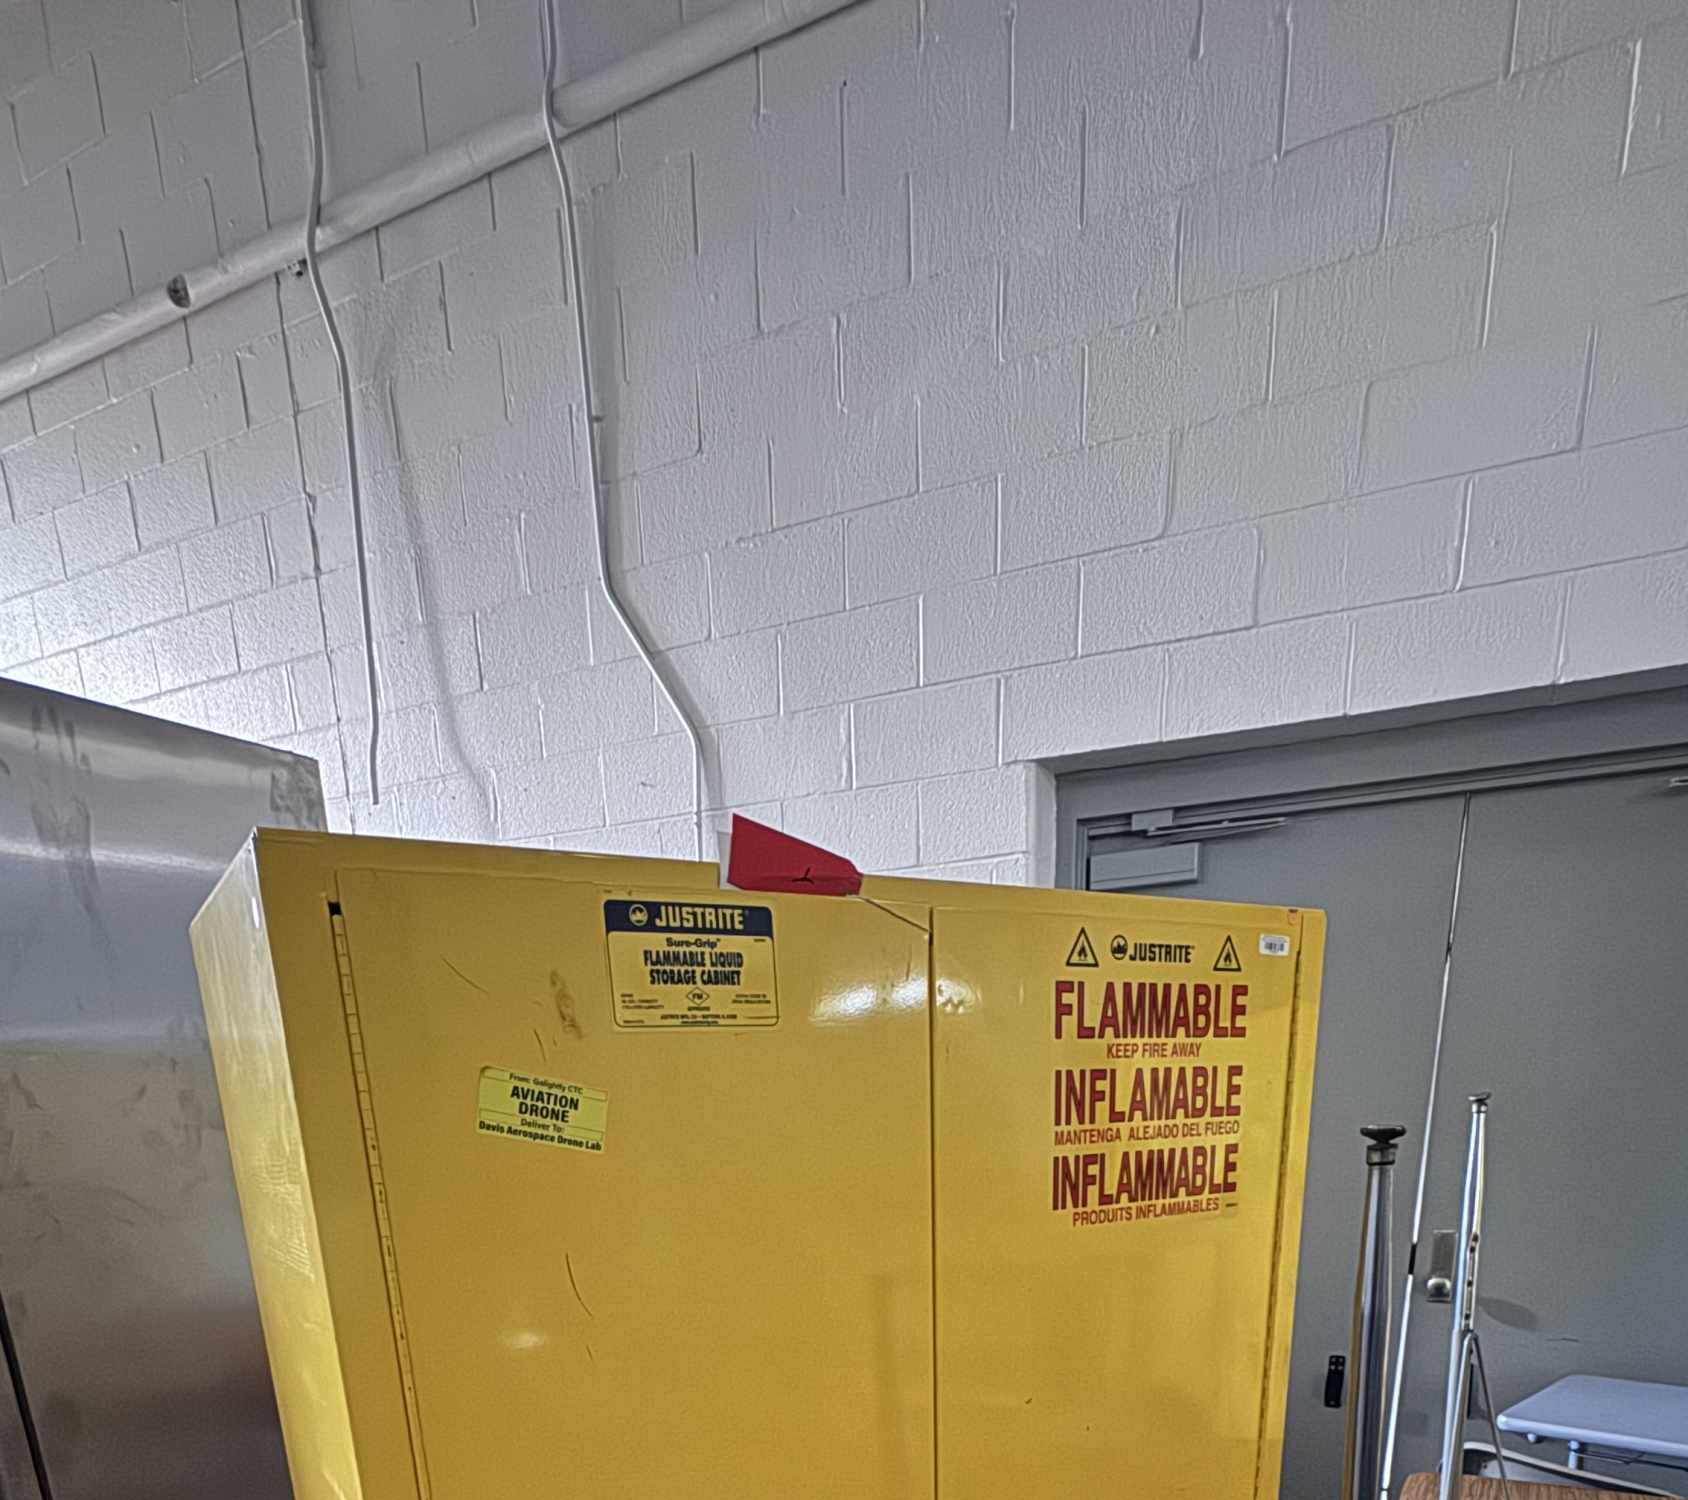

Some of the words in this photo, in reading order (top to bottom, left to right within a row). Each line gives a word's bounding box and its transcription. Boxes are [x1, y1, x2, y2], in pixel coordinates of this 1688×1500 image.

[655, 904, 744, 930] JUSTRITE
[643, 949, 706, 968] FLAMMABLE
[709, 951, 744, 968] LIQUID
[1129, 942, 1193, 963] JUSTRITE
[649, 968, 697, 985] STORAGE
[700, 969, 741, 986] CABINET
[1054, 980, 1249, 1039] FLAMMABLE
[1106, 1042, 1139, 1059] KEEP
[1142, 1042, 1168, 1058] FIRE
[1170, 1041, 1202, 1058] AWAY
[510, 1085, 579, 1111] AVIATION
[1054, 1065, 1243, 1127] INFLAMABLE
[518, 1101, 570, 1123] DRONE
[521, 1118, 550, 1132] Deliver
[506, 1125, 556, 1143] Aerospace
[557, 1135, 584, 1148] Drone
[585, 1140, 602, 1151] Lab
[1054, 1127, 1122, 1146] MANTENGA
[1127, 1124, 1180, 1141] ALEJADO
[1182, 1122, 1202, 1138] DEL
[1204, 1120, 1240, 1137] FUEGO
[1052, 1143, 1240, 1211] INFLAMMABLE
[1072, 1206, 1133, 1228] PRODUITS
[1135, 1197, 1220, 1220] INFLAMMABLES
